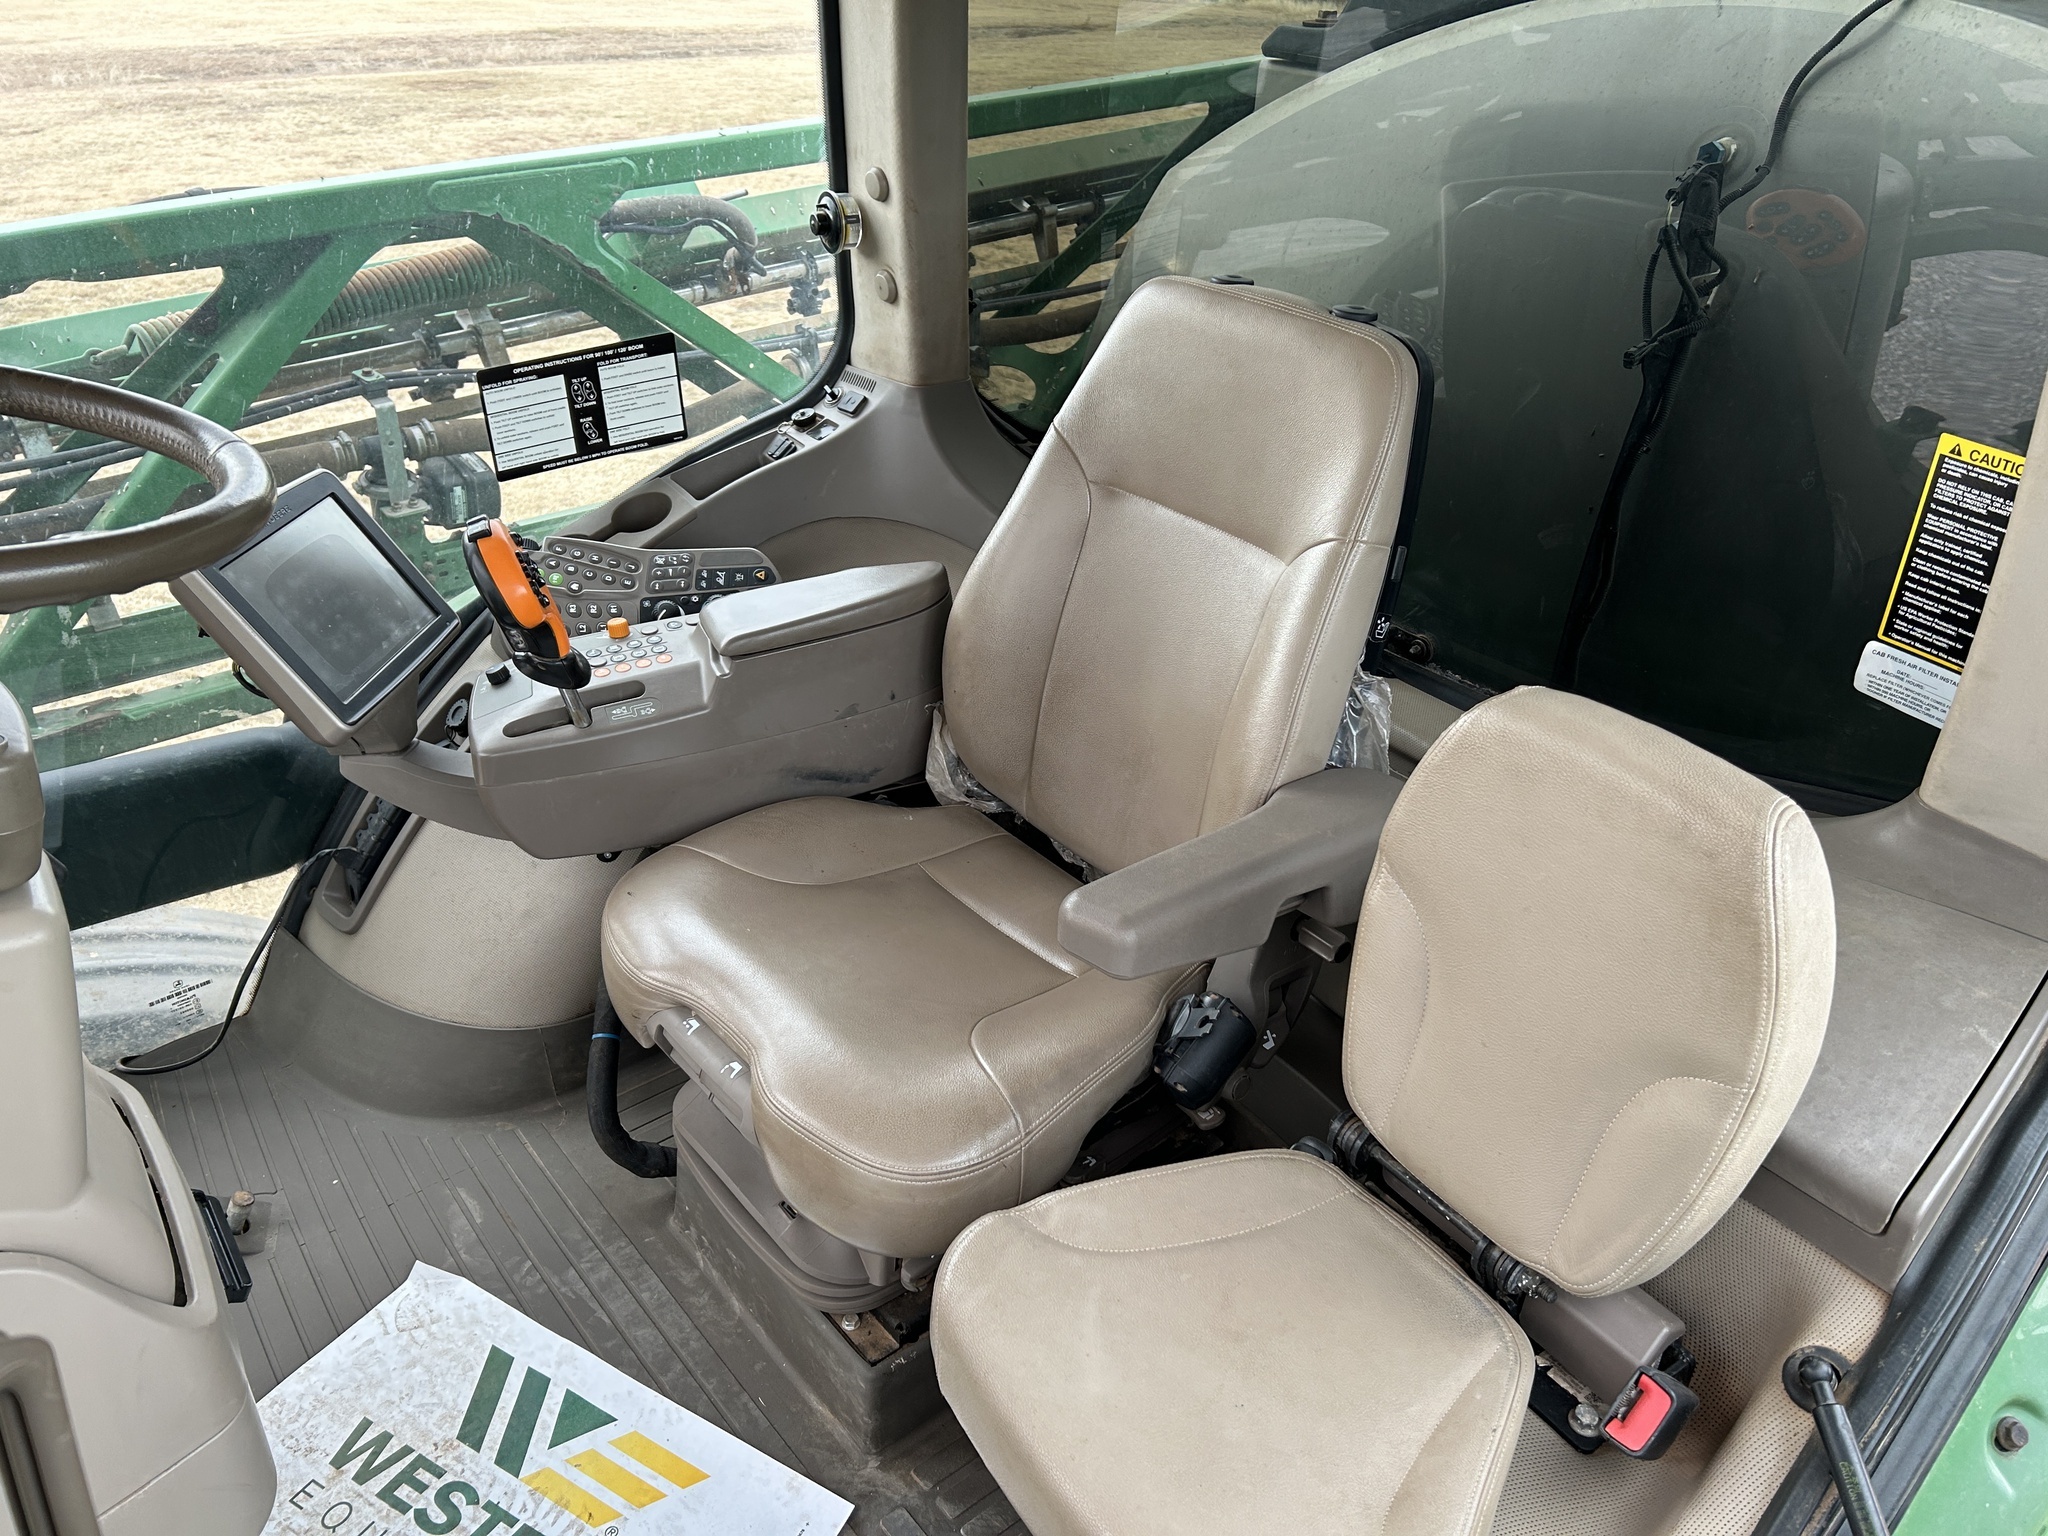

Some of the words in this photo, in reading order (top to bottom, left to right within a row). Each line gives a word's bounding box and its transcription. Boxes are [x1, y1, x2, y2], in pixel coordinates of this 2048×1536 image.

[1933, 493, 1959, 506] CHEMICAL
[1936, 483, 1963, 496] PRESSURE
[1946, 480, 1957, 488] NOT
[1957, 484, 1971, 492] RELY
[1980, 491, 1992, 499] THIS
[1934, 488, 1955, 498] FILTERS
[1963, 497, 1987, 509] PROTECT
[1987, 505, 2010, 517] AGAINST
[1926, 513, 1939, 521] Wear
[1939, 517, 1966, 530] PERSONAL
[1966, 527, 1998, 542] PROTECTIVE
[1872, 649, 1886, 658] CAB
[1886, 654, 1906, 666] FRESH
[1907, 662, 1918, 670] AIR
[1918, 667, 1938, 679] FILTER
[1881, 669, 1905, 683] MACHINE
[328, 1416, 547, 1536] WEST
